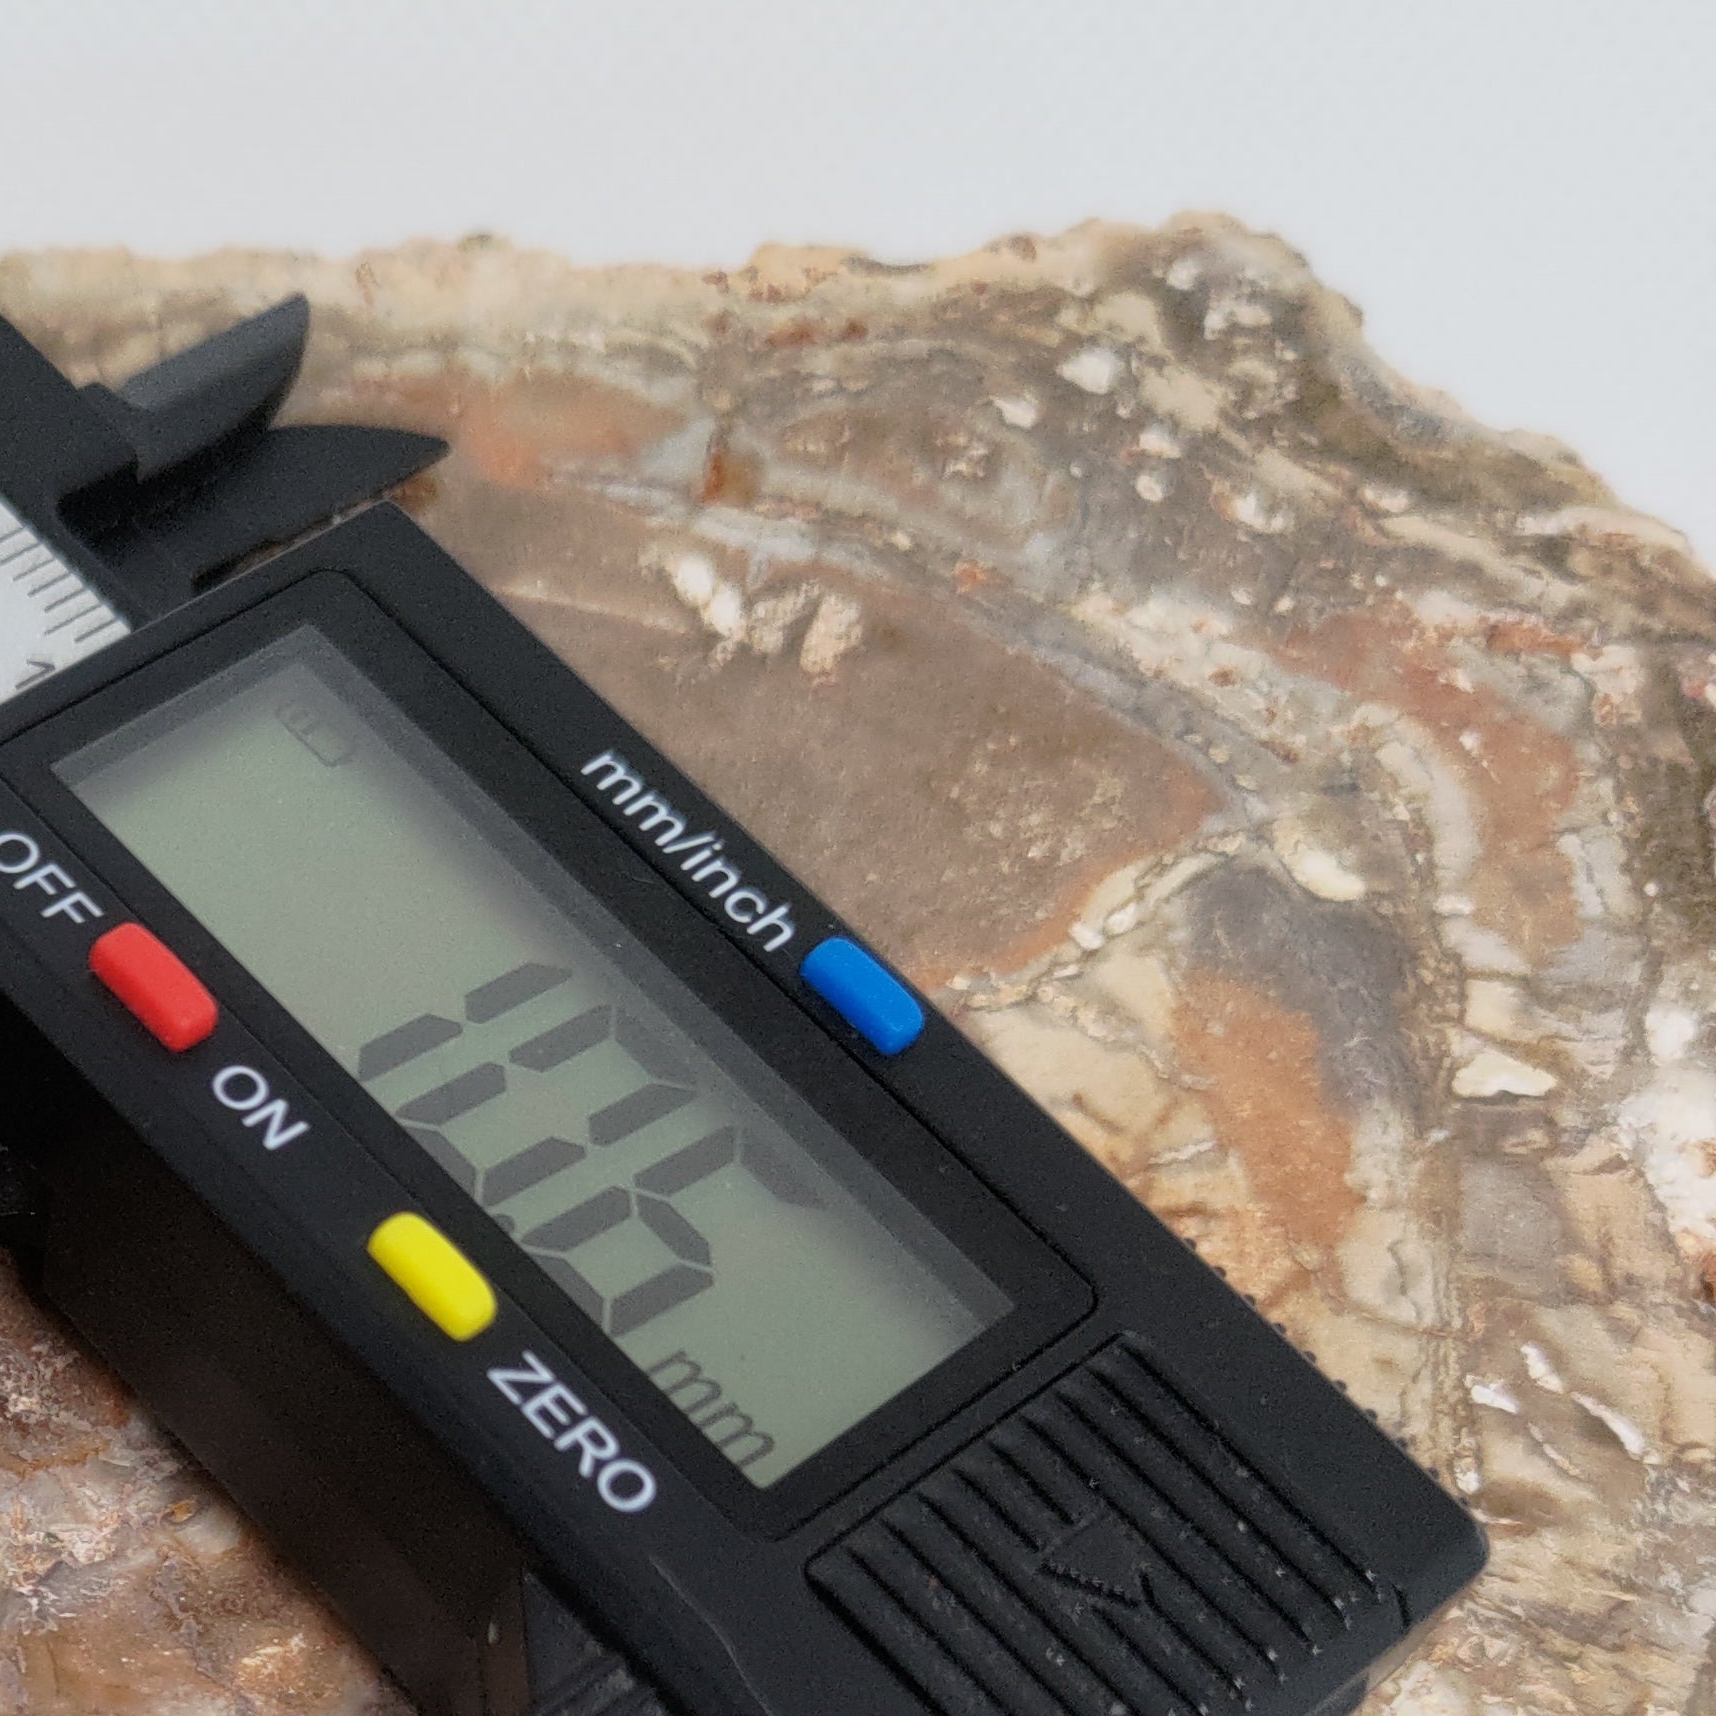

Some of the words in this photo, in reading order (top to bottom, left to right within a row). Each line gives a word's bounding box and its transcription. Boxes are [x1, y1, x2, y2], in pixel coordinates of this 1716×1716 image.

[580, 752, 796, 952] mm/inch
[212, 1065, 309, 1150] ON
[487, 1350, 657, 1512] ZERO
[649, 1350, 775, 1467] mm
